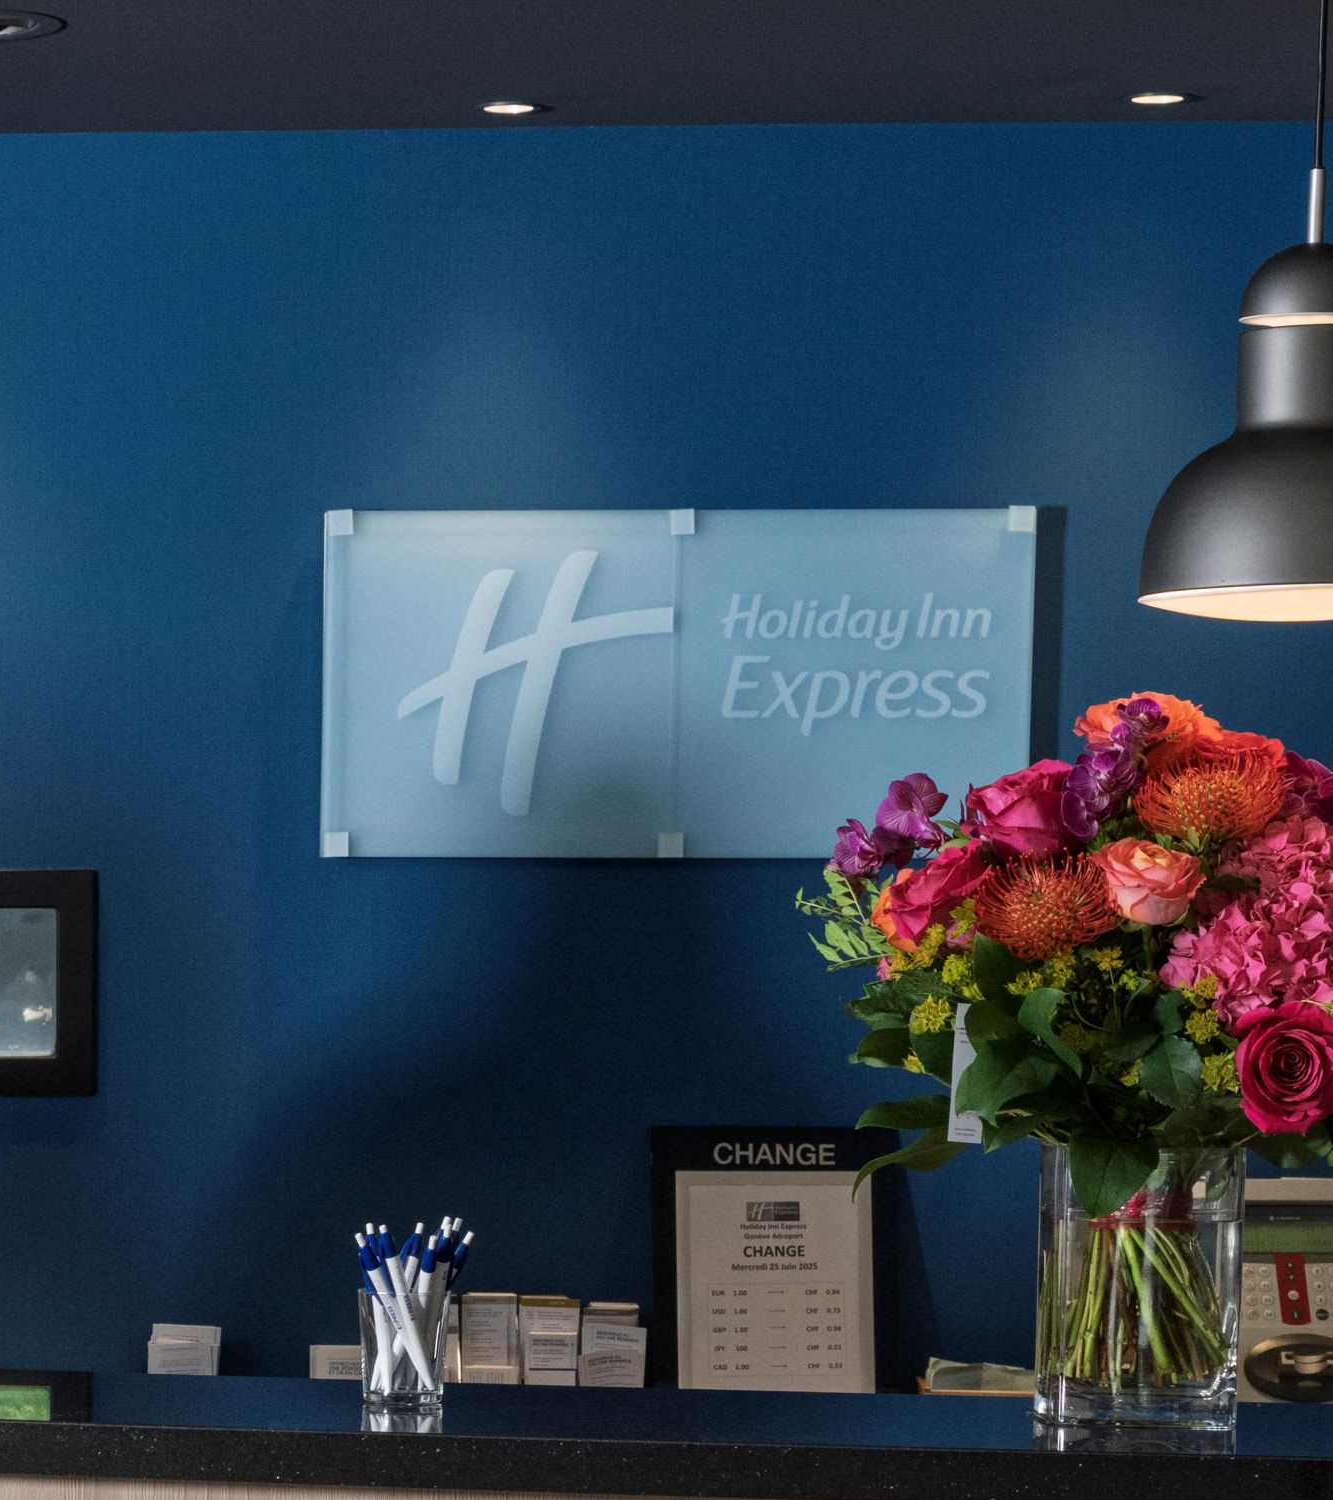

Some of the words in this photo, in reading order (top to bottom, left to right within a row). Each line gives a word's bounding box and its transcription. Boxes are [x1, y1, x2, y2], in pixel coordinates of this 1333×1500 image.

[721, 593, 912, 650] Holiday
[917, 592, 992, 638] Inn
[721, 655, 990, 736] Express
[713, 1142, 836, 1166] CHANGE
[740, 1223, 766, 1231] Holiday
[781, 1223, 807, 1231] Express
[743, 1245, 805, 1258] CHANGE
[731, 1263, 768, 1271] Mercredi
[769, 1263, 779, 1271] 25
[799, 1262, 818, 1270] 2025
[711, 1289, 726, 1297] EUR
